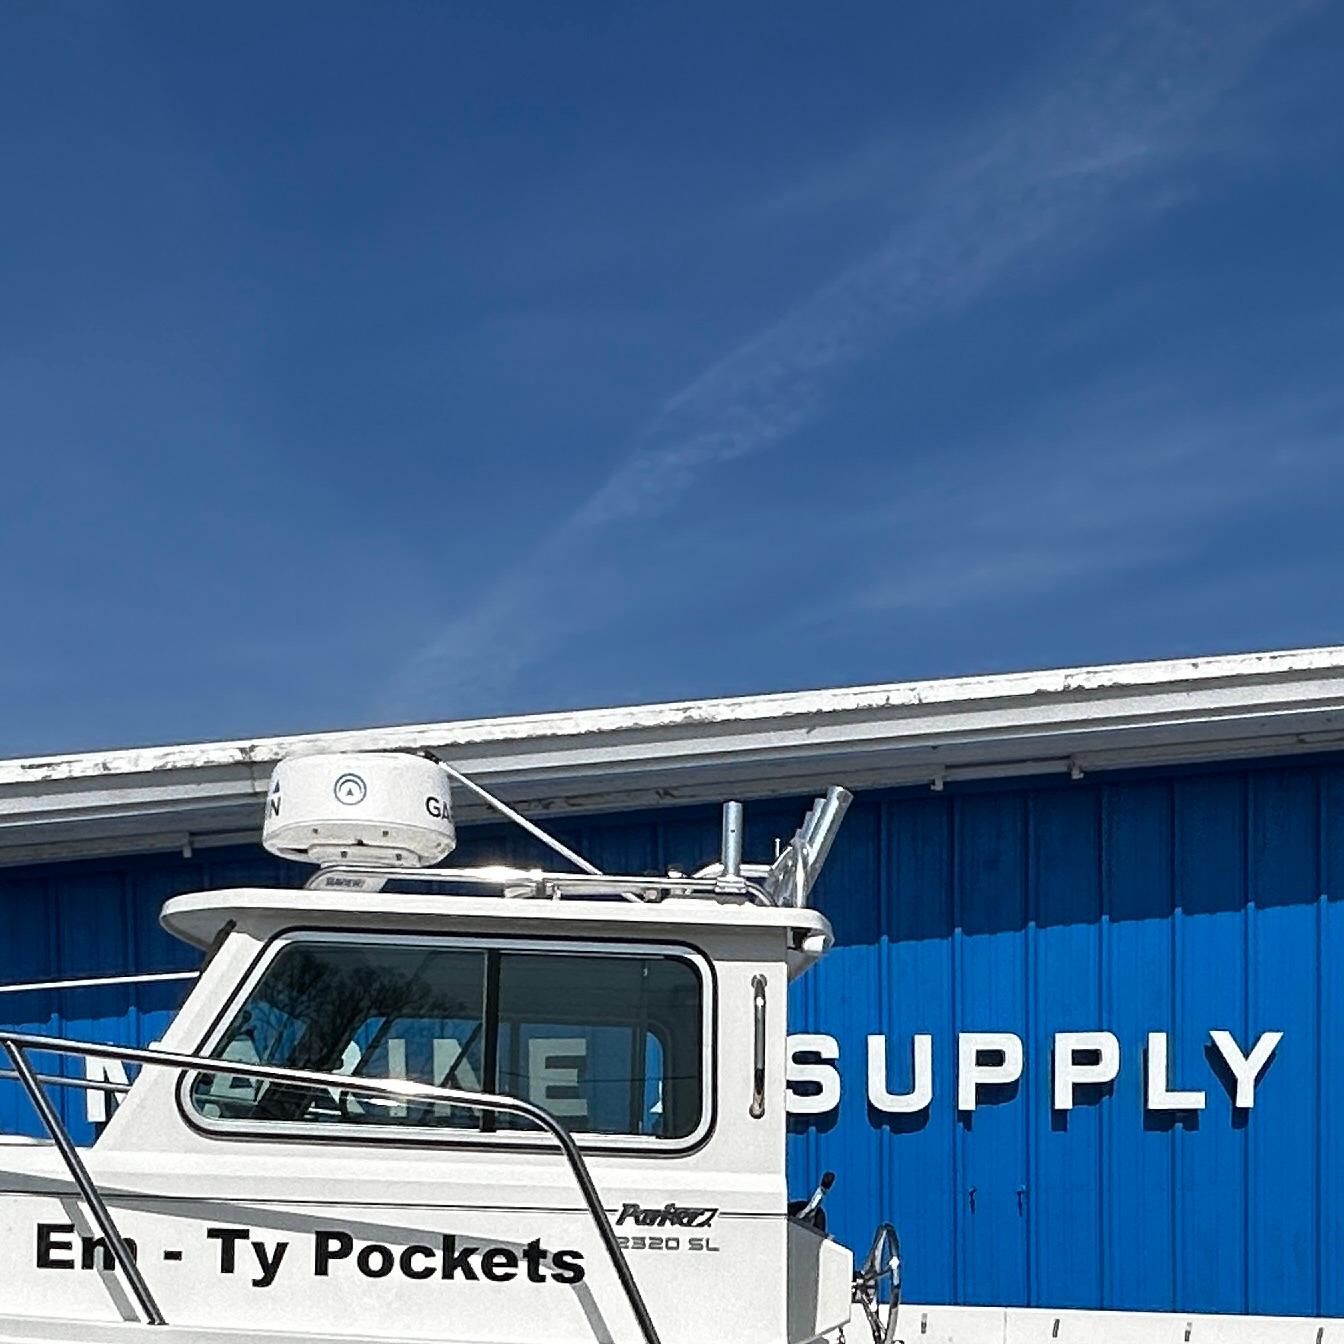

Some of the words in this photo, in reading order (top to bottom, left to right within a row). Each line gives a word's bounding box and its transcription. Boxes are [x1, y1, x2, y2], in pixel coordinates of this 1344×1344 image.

[785, 1029, 1285, 1115] SUPPLY
[616, 1202, 719, 1228] Parker
[36, 1222, 137, 1271] Em
[206, 1227, 290, 1288] Ty
[314, 1230, 586, 1285] Pockets
[616, 1235, 680, 1251] 2320
[687, 1236, 720, 1252] SL
